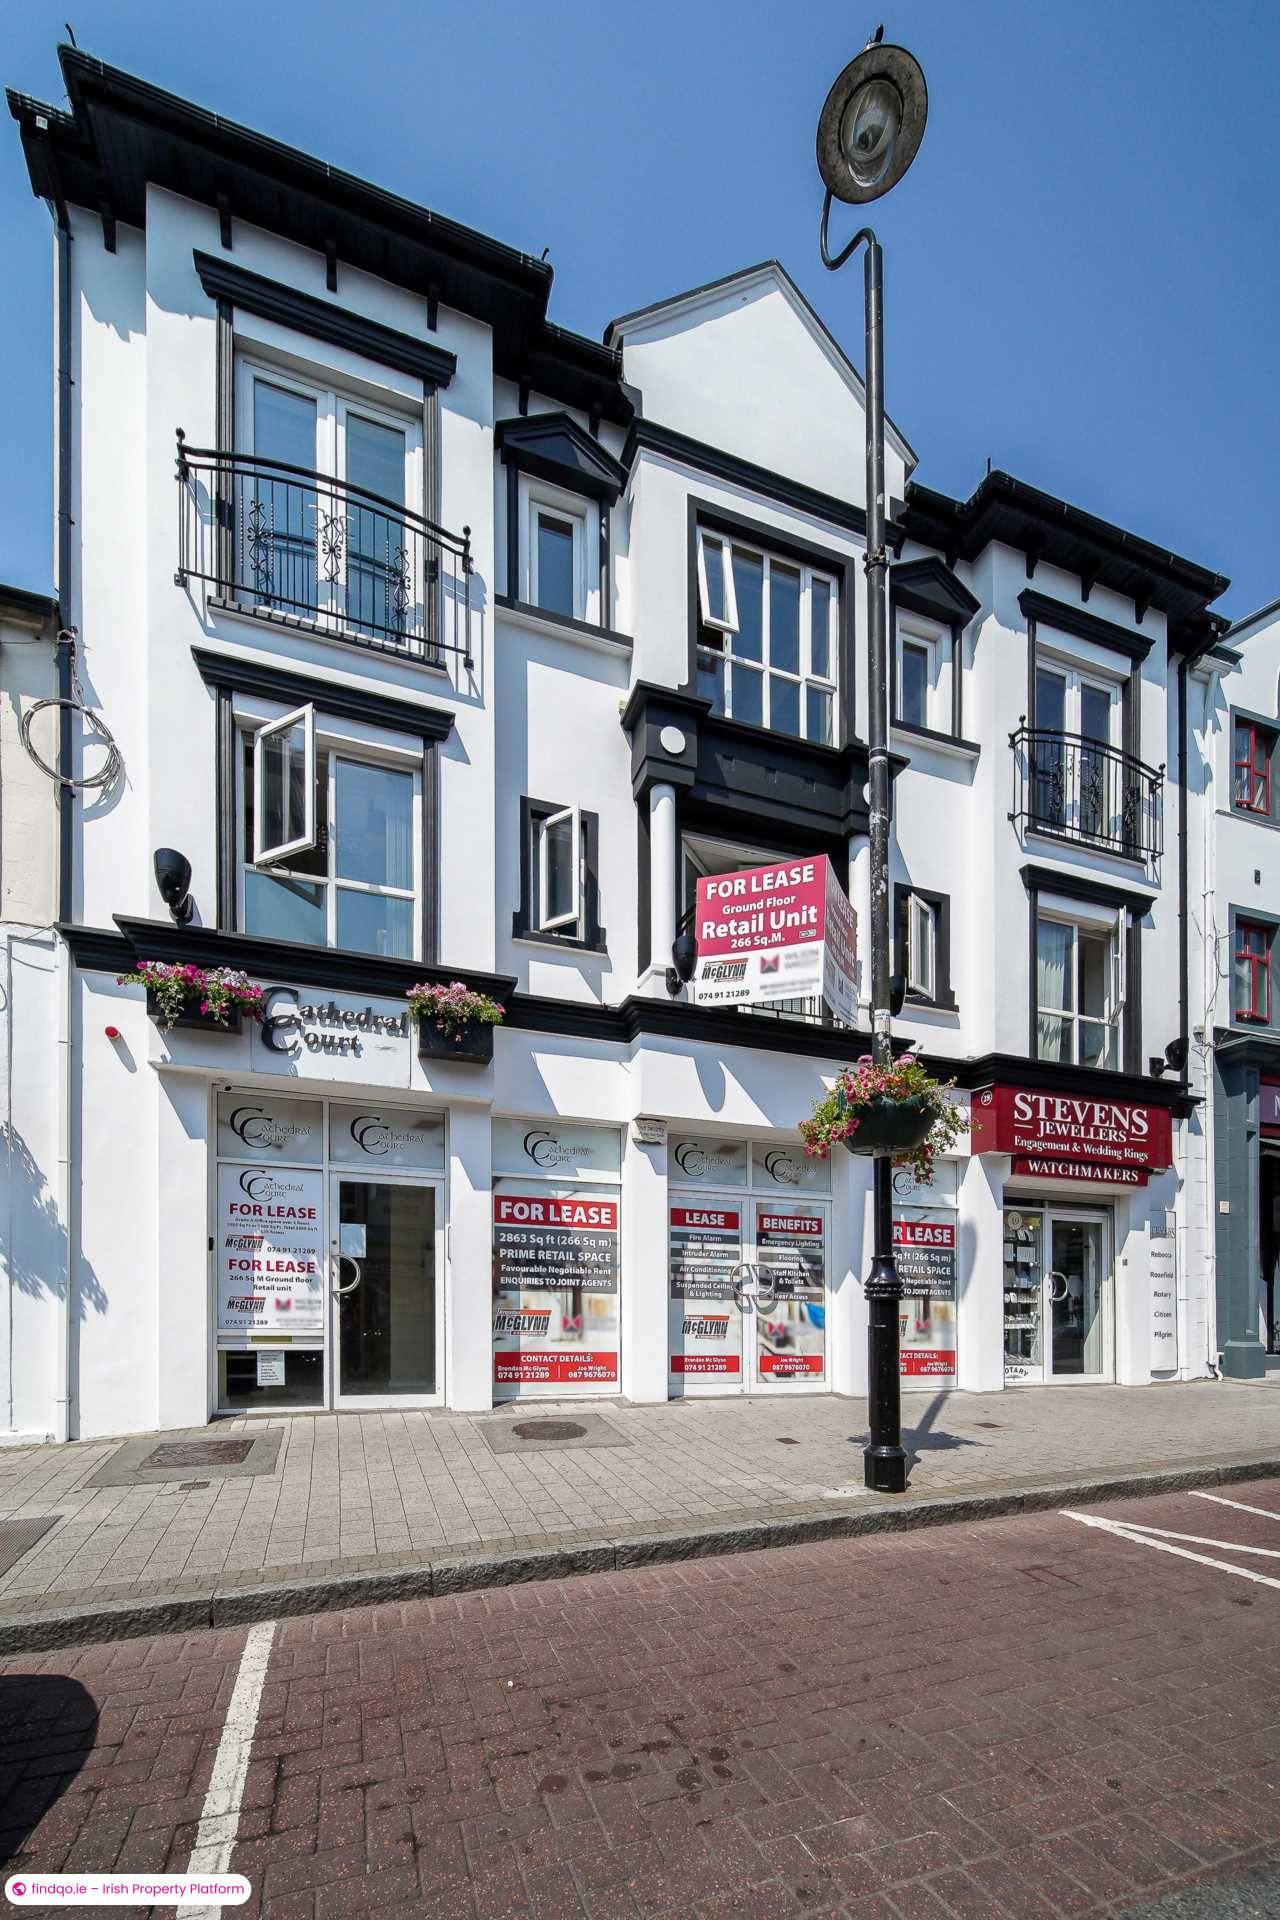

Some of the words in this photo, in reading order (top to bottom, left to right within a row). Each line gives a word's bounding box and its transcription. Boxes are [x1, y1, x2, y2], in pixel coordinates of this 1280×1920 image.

[706, 879, 746, 900] FOR
[751, 864, 814, 893] LEASE
[722, 900, 763, 915] Ground
[766, 895, 796, 908] Floor
[702, 913, 764, 940] Retail
[770, 905, 818, 929] Unit
[730, 937, 751, 949] 266
[754, 932, 785, 947] Sq.M.
[698, 992, 713, 1000] 074
[725, 989, 750, 998] 21289
[262, 986, 409, 1035] Cathedral
[262, 1015, 362, 1052] Court
[1014, 1093, 1149, 1135] STEVENS
[1037, 1121, 1127, 1143] JEWELLERS
[1014, 1136, 1070, 1152] Engagement
[1072, 1143, 1081, 1153] &
[1083, 1144, 1123, 1160] Wedding
[1124, 1148, 1149, 1162] Rings
[1028, 1160, 1138, 1182] WATCHMAKERS
[229, 1203, 263, 1216] FOR
[267, 1206, 316, 1220] LEASE
[500, 1201, 544, 1221] FOR
[549, 1205, 612, 1224] LEASE
[685, 1212, 725, 1225] LEASE
[763, 1218, 819, 1232] BENEFITS
[499, 1233, 527, 1243] 2863
[530, 1234, 543, 1246] Sq
[545, 1234, 555, 1244] ft
[557, 1235, 581, 1247] (266
[583, 1237, 596, 1248] Sq
[598, 1237, 612, 1249] m)
[906, 1226, 951, 1243] LEASE
[761, 1238, 794, 1246] Emergency
[795, 1240, 820, 1249] Lighting
[499, 1248, 536, 1259] PRIME
[538, 1250, 575, 1261] RETAIL
[577, 1252, 612, 1262] SPACE
[779, 1255, 804, 1263] Flooring
[892, 1251, 903, 1260] Sq
[912, 1252, 928, 1262] (266
[930, 1253, 940, 1264] Sq
[941, 1255, 951, 1263] m)
[228, 1259, 262, 1272] FOR
[266, 1260, 316, 1274] LEASE
[500, 1264, 547, 1273] Favourable
[548, 1266, 592, 1276] Negotiable
[690, 1266, 731, 1274] Conditioning
[898, 1265, 926, 1274] RETAIL
[926, 1266, 951, 1275] SPACE
[245, 1275, 254, 1283] Sq
[500, 1276, 544, 1285] ENQUIRIES
[545, 1278, 556, 1286] TO
[556, 1278, 580, 1286] JOINT
[676, 1282, 712, 1290] Suspended
[695, 1290, 722, 1298] Lighting
[1153, 1290, 1171, 1299] Rotary
[227, 1300, 266, 1310] McGLYNN
[495, 1315, 550, 1331] McGLYNN
[681, 1321, 729, 1334] McGLYNN
[1154, 1331, 1173, 1340] Pilgrim
[521, 1355, 558, 1363] CONTACT
[559, 1355, 593, 1363] DETAILS:
[1004, 1366, 1029, 1376] OTARY
